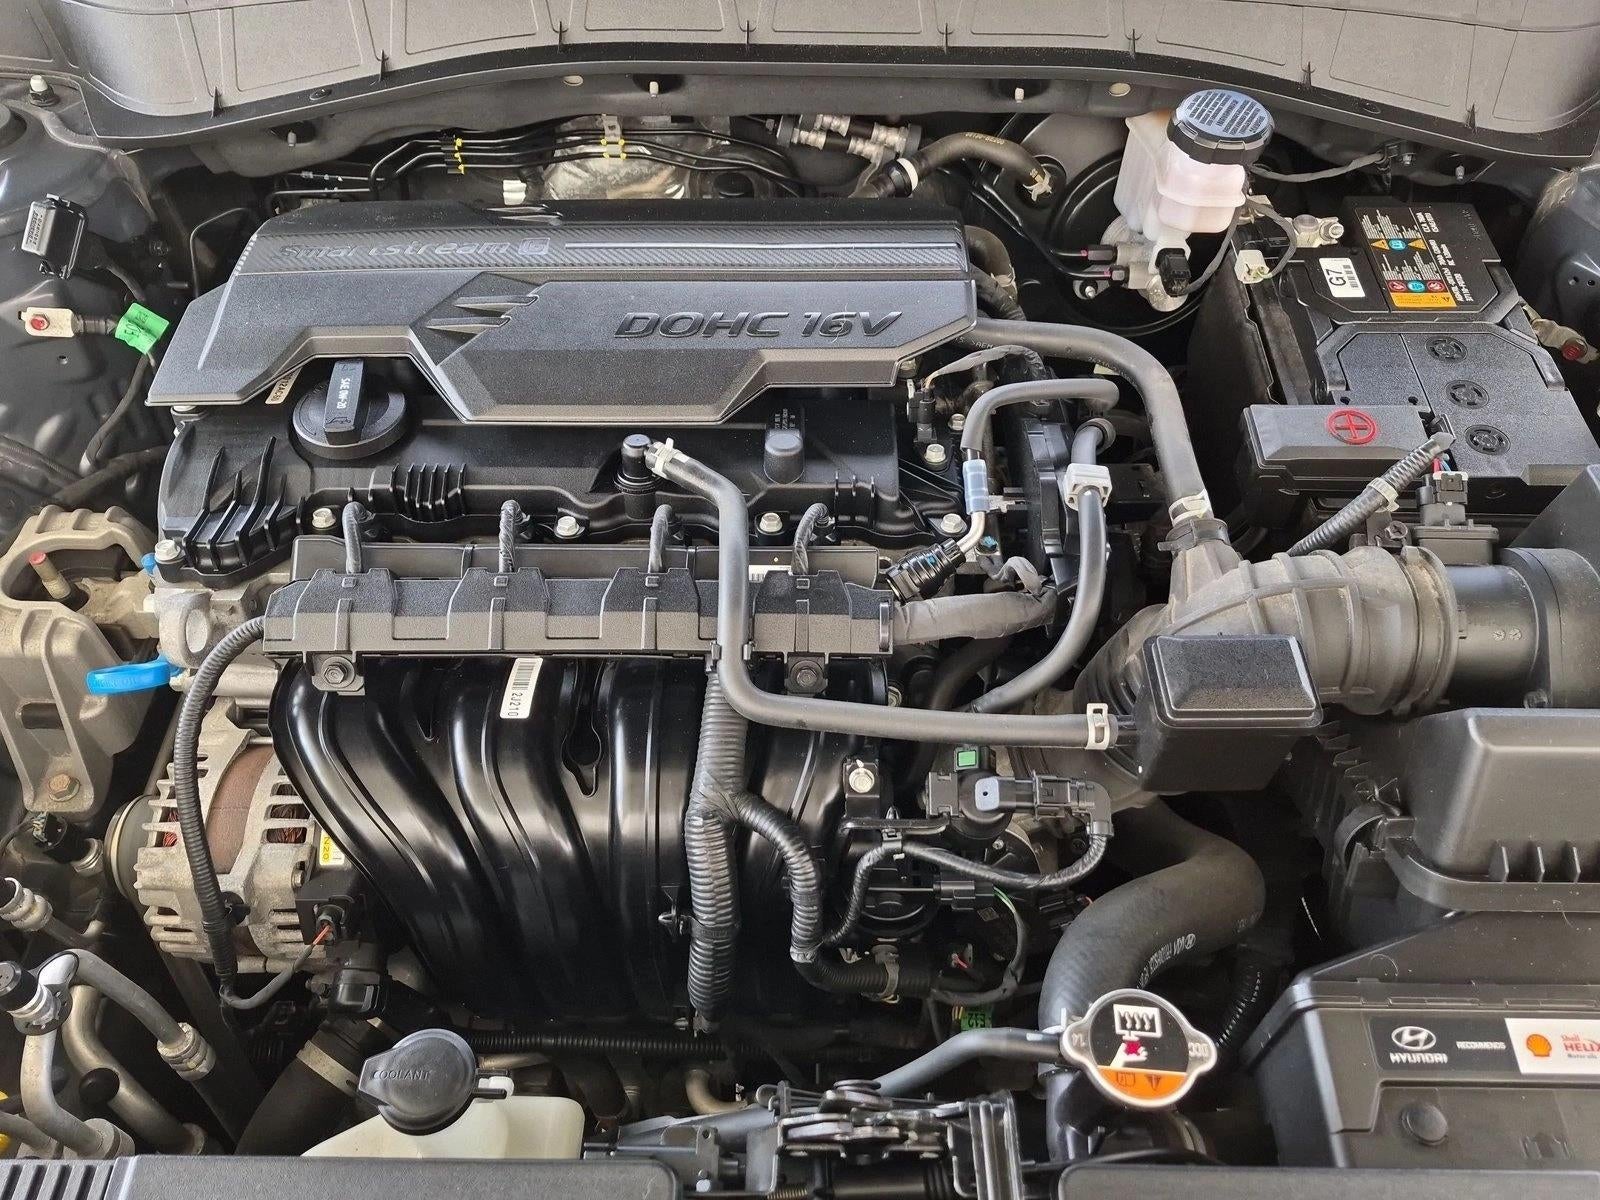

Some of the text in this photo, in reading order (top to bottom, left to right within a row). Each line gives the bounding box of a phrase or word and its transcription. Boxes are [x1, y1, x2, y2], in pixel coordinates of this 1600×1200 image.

[1325, 268, 1347, 286] G7
[613, 311, 903, 338] DOHC 16V
[1456, 1041, 1506, 1050] RECOMMENDS
[1389, 1052, 1449, 1064] HYUNDAI
[372, 1069, 431, 1081] COOLANT
